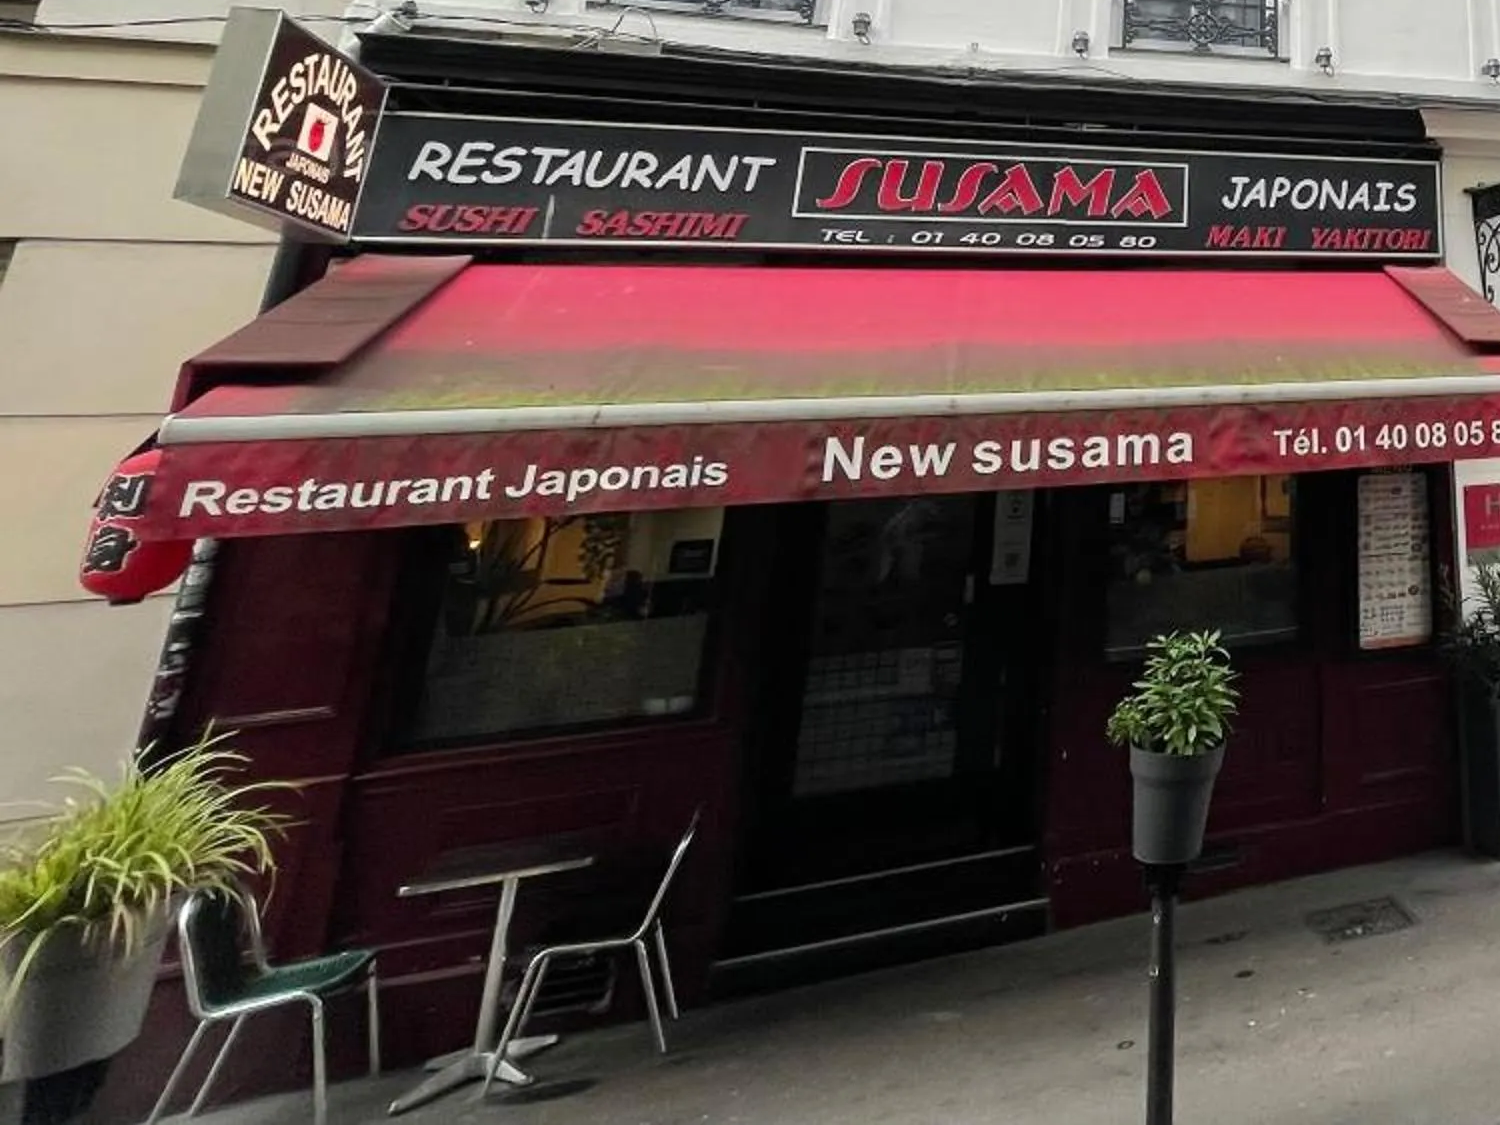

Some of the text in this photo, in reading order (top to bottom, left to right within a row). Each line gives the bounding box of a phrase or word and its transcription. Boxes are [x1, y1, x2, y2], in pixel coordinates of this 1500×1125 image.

[251, 52, 366, 183] RESTAURANT
[233, 157, 351, 232] NEW SUSAMA
[407, 140, 1417, 220] RESTAURANT SUSAMA JAPONAIS
[401, 204, 749, 239] SUSHI SASHIMI
[821, 228, 870, 243] TEL
[911, 230, 943, 245] 01
[959, 231, 1001, 246] 40
[1016, 232, 1055, 247] 08
[1068, 233, 1105, 248] 05
[1119, 234, 1157, 248] 80
[1205, 225, 1432, 250] MAKI YAKITORI
[821, 430, 1194, 483] New susama
[1273, 427, 1328, 457] Tél.
[1334, 426, 1366, 452] 01
[1374, 424, 1408, 450] 40
[1414, 422, 1448, 449] 08
[1453, 420, 1485, 447] 05
[177, 456, 729, 518] Restaurant Japonais
